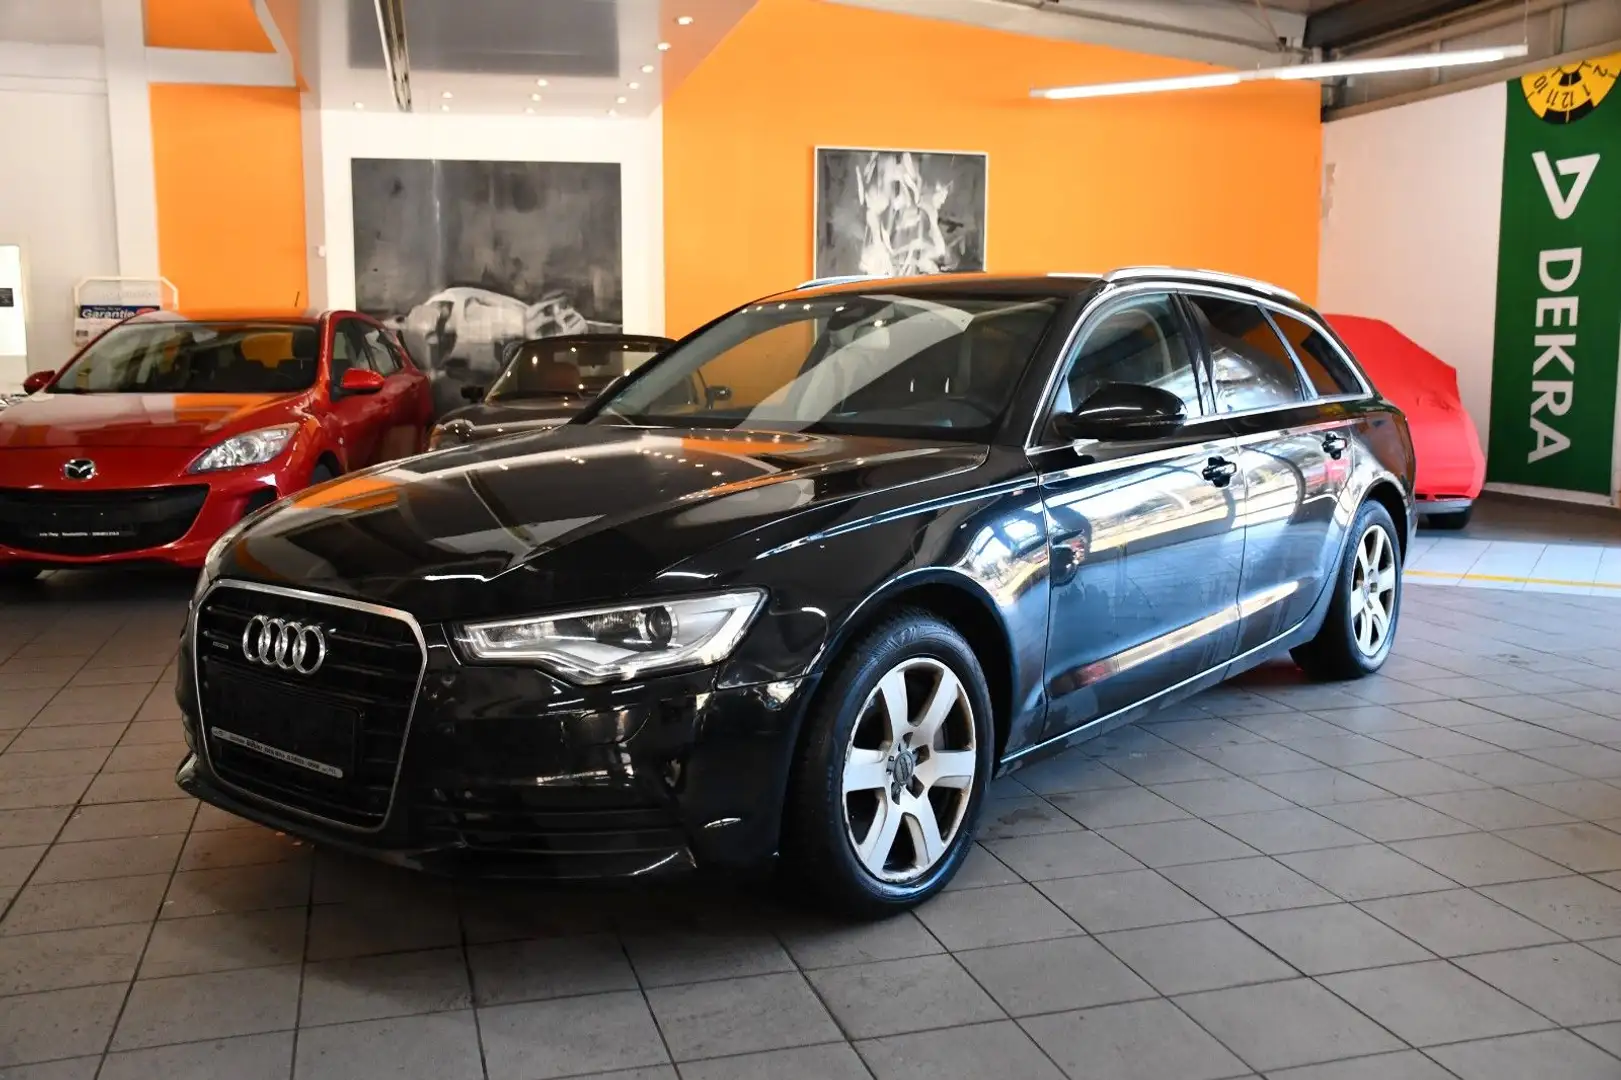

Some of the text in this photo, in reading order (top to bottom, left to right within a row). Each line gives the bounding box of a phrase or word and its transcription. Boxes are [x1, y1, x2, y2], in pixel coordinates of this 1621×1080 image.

[1593, 64, 1609, 78] 2
[1533, 74, 1549, 95] 10
[1582, 83, 1592, 97] 1
[1546, 89, 1559, 106] 11
[1561, 91, 1574, 109] 12
[81, 308, 136, 319] Garantie
[1527, 247, 1582, 464] DEKRA
